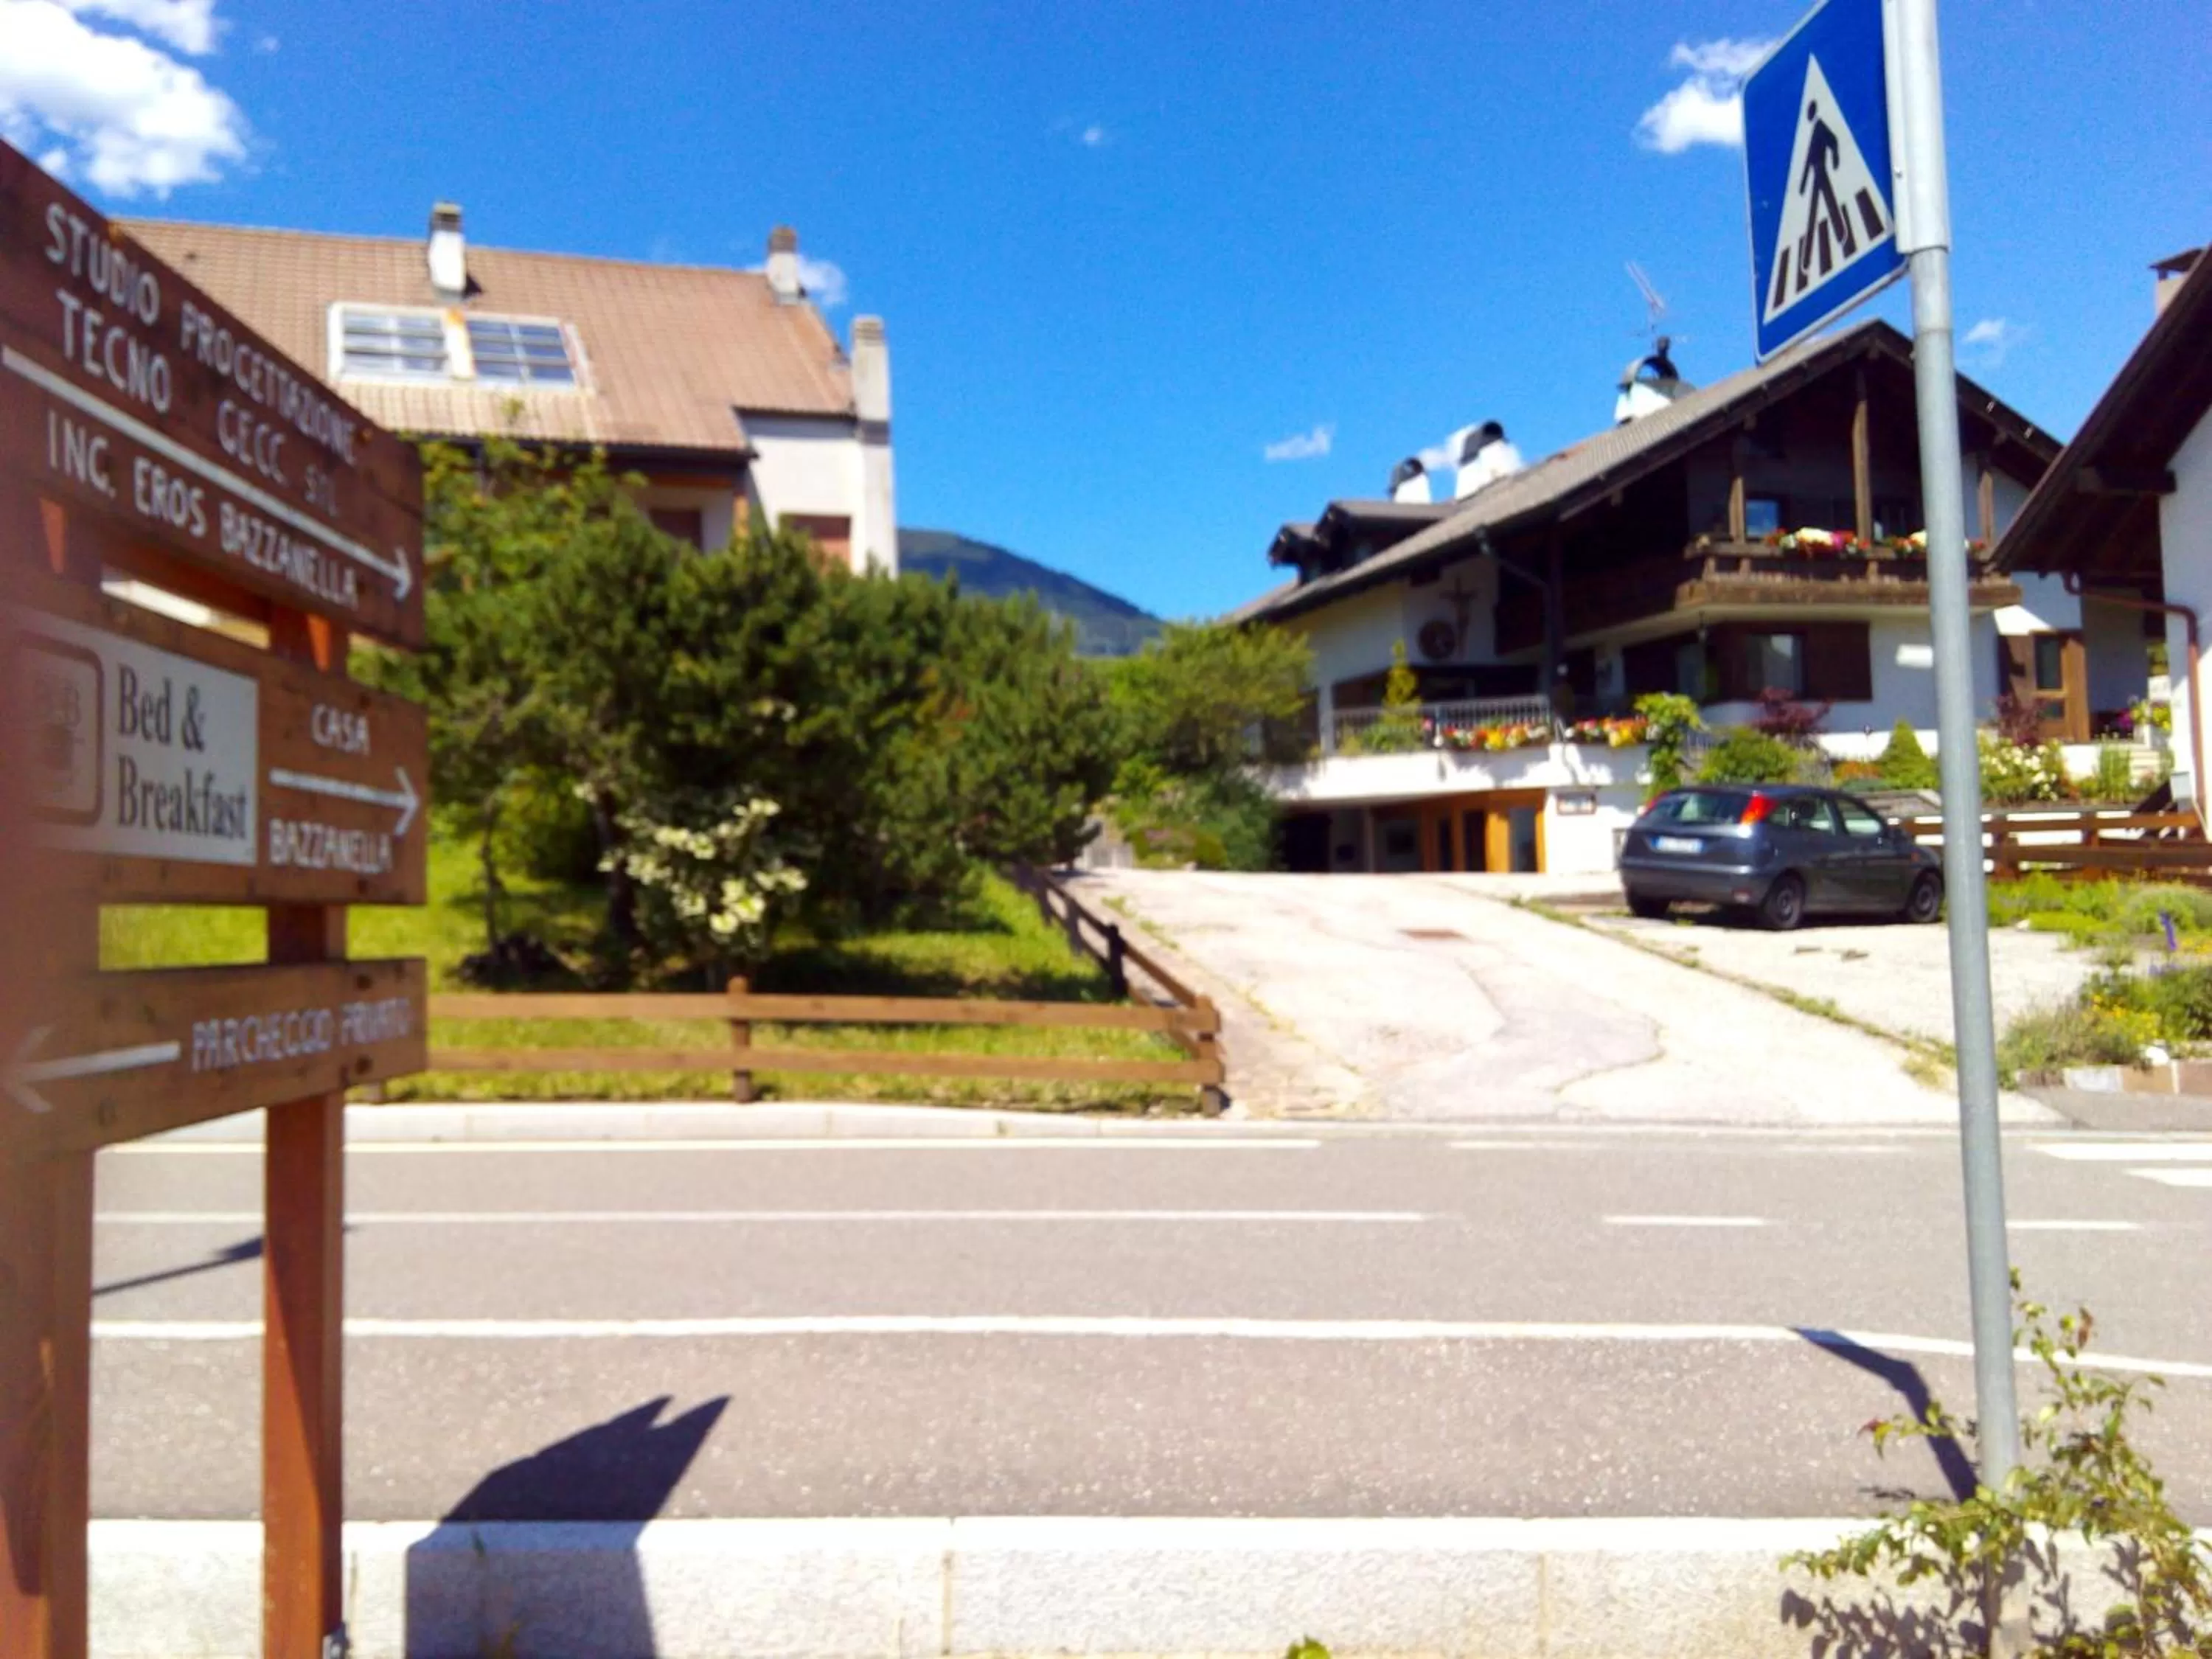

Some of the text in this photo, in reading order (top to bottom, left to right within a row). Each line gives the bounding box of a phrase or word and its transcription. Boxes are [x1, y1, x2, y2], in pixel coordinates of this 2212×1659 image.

[46, 202, 159, 324] STUDIO
[56, 288, 171, 413] TECNO
[134, 456, 208, 538] EROS
[221, 502, 358, 611] BAZZANELLA
[119, 662, 171, 746] Bed
[182, 684, 206, 752] &
[311, 703, 370, 755] CASA
[119, 754, 246, 841] Breakfast
[270, 818, 392, 874] BAZZANELLA
